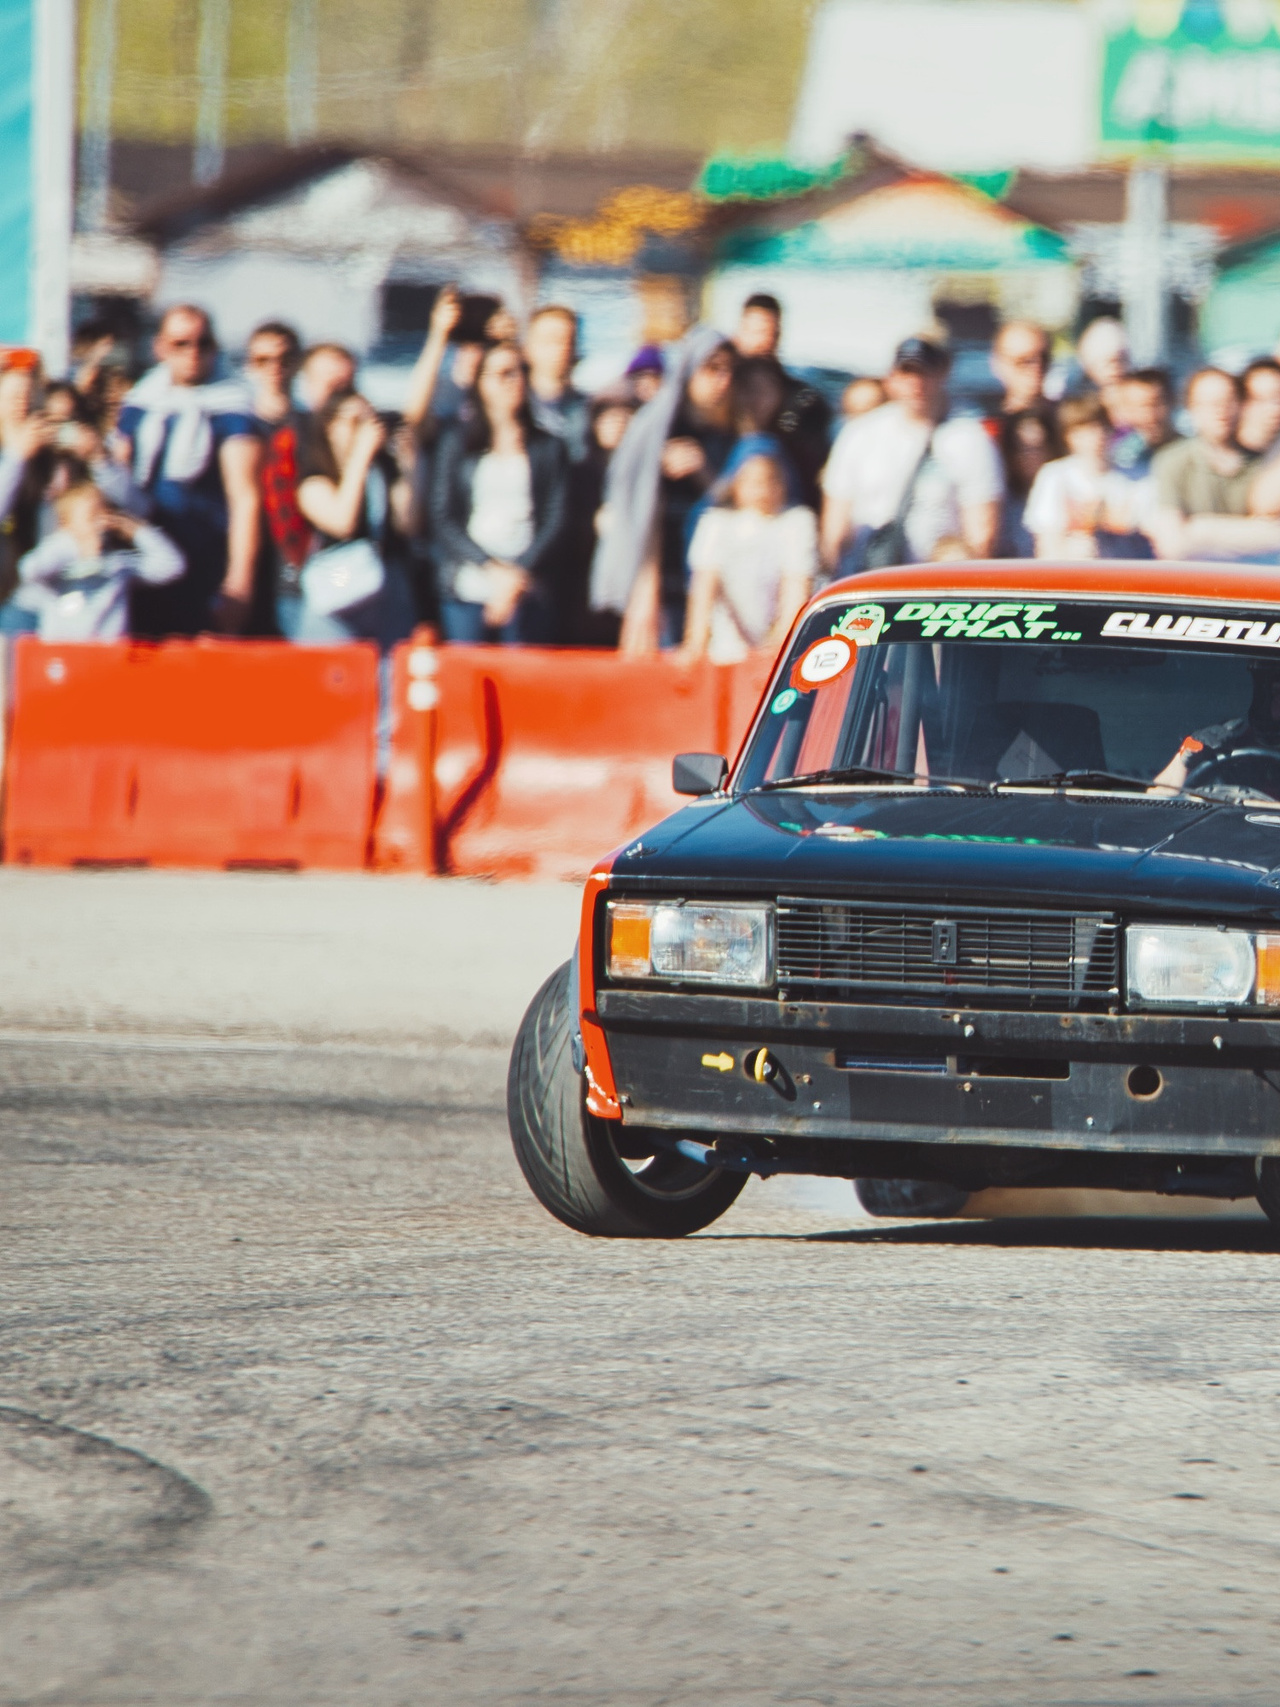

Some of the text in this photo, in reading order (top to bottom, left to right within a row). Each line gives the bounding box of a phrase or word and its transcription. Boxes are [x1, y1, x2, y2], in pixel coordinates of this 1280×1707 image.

[893, 602, 1057, 622] DRIFT
[920, 619, 1082, 641] THAT...
[813, 651, 838, 669] 12
